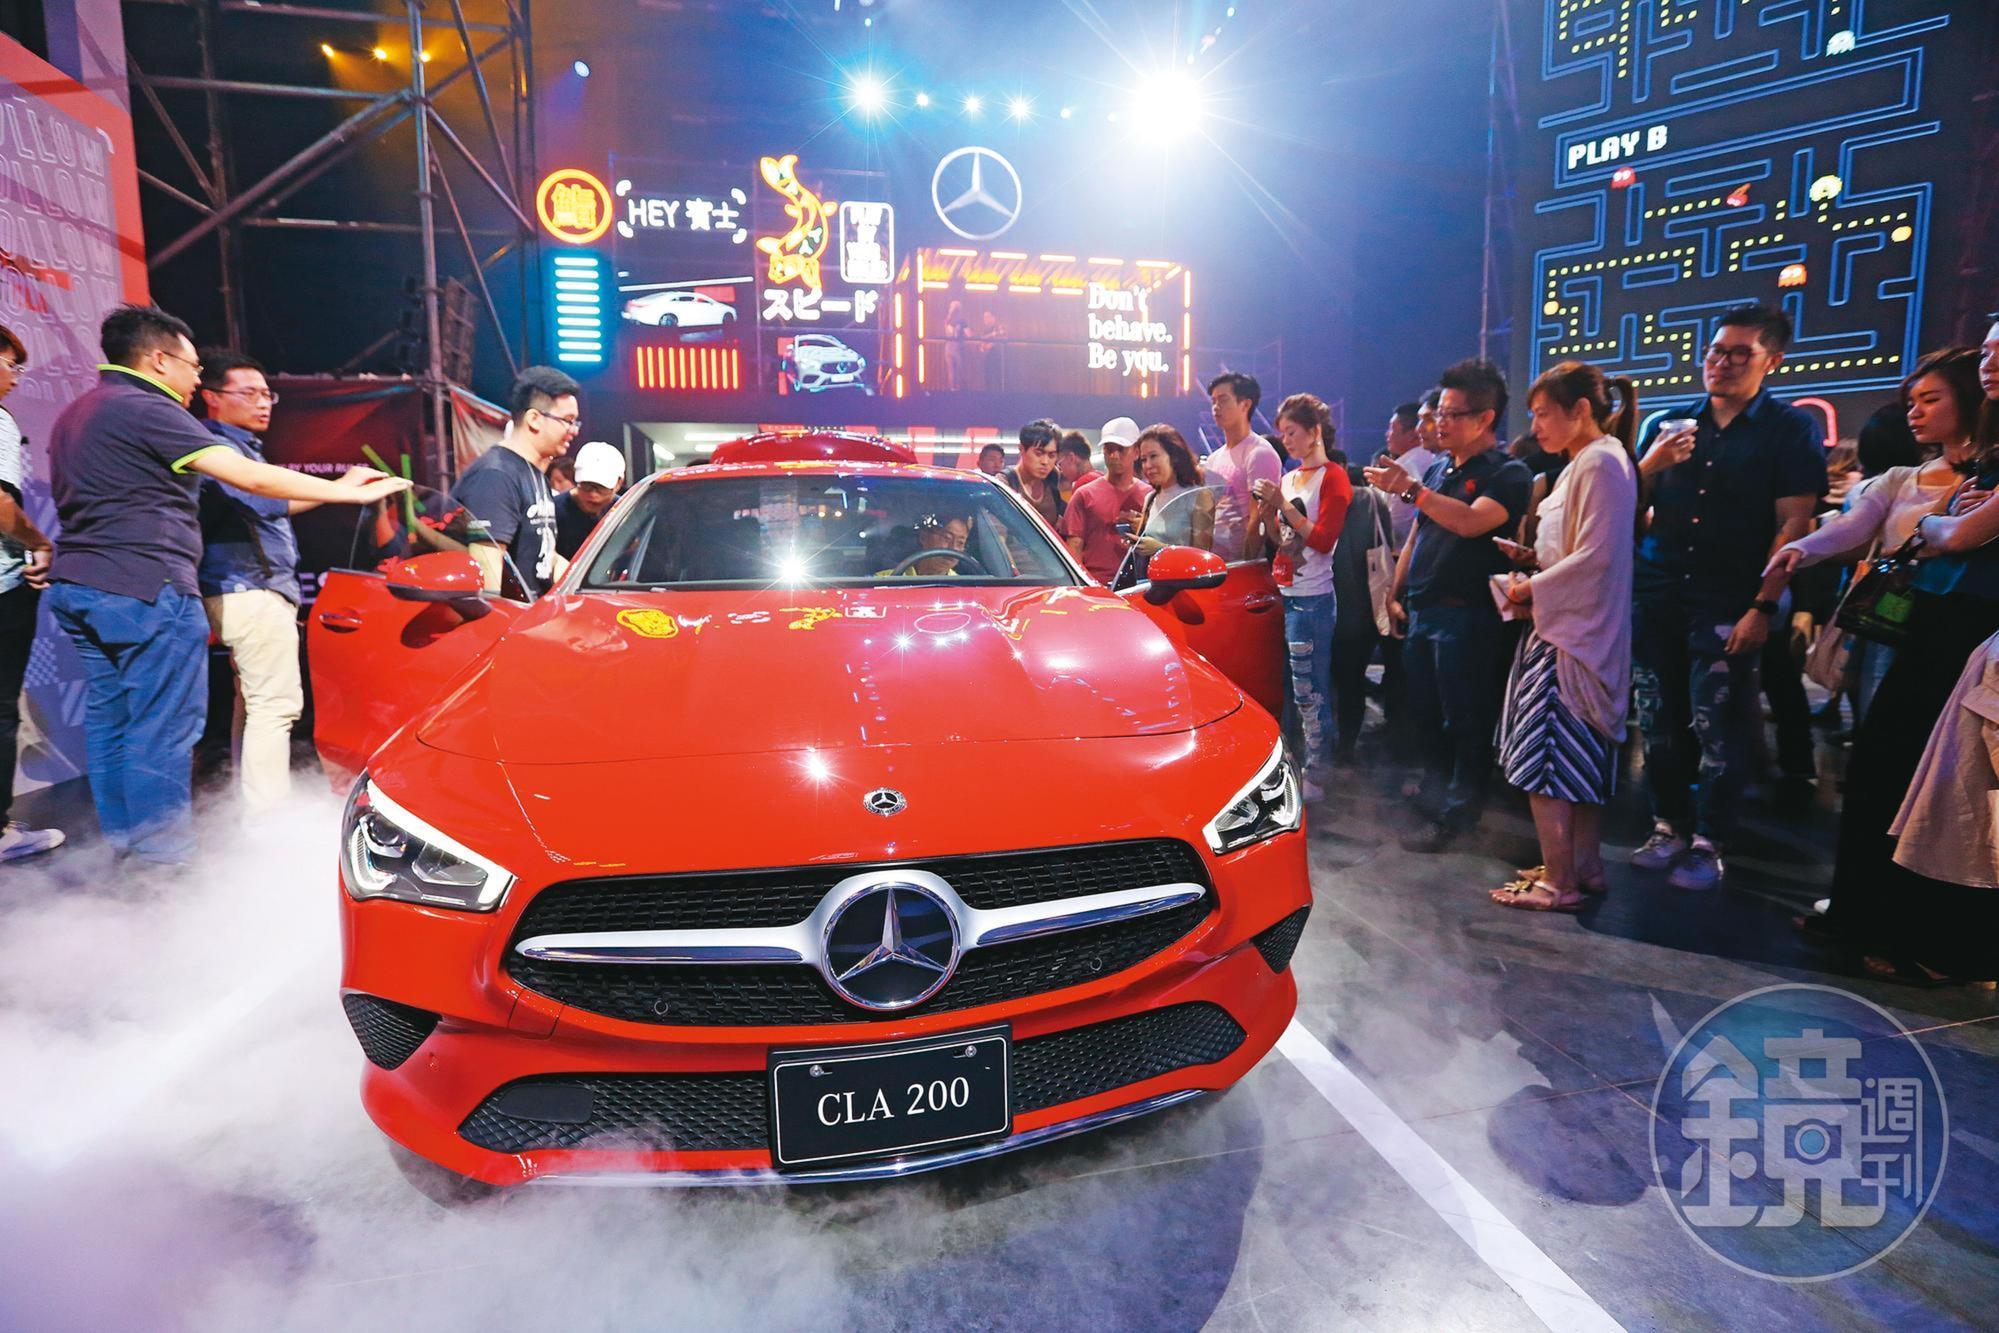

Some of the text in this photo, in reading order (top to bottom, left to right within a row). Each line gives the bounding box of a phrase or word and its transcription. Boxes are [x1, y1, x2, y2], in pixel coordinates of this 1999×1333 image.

[1567, 124, 1668, 170] PLAY B
[628, 199, 680, 228] HEY
[1088, 281, 1148, 312] Don't
[1088, 313, 1173, 343] behave.
[1088, 342, 1170, 377] Be you.
[817, 1076, 970, 1126] CLA 200
